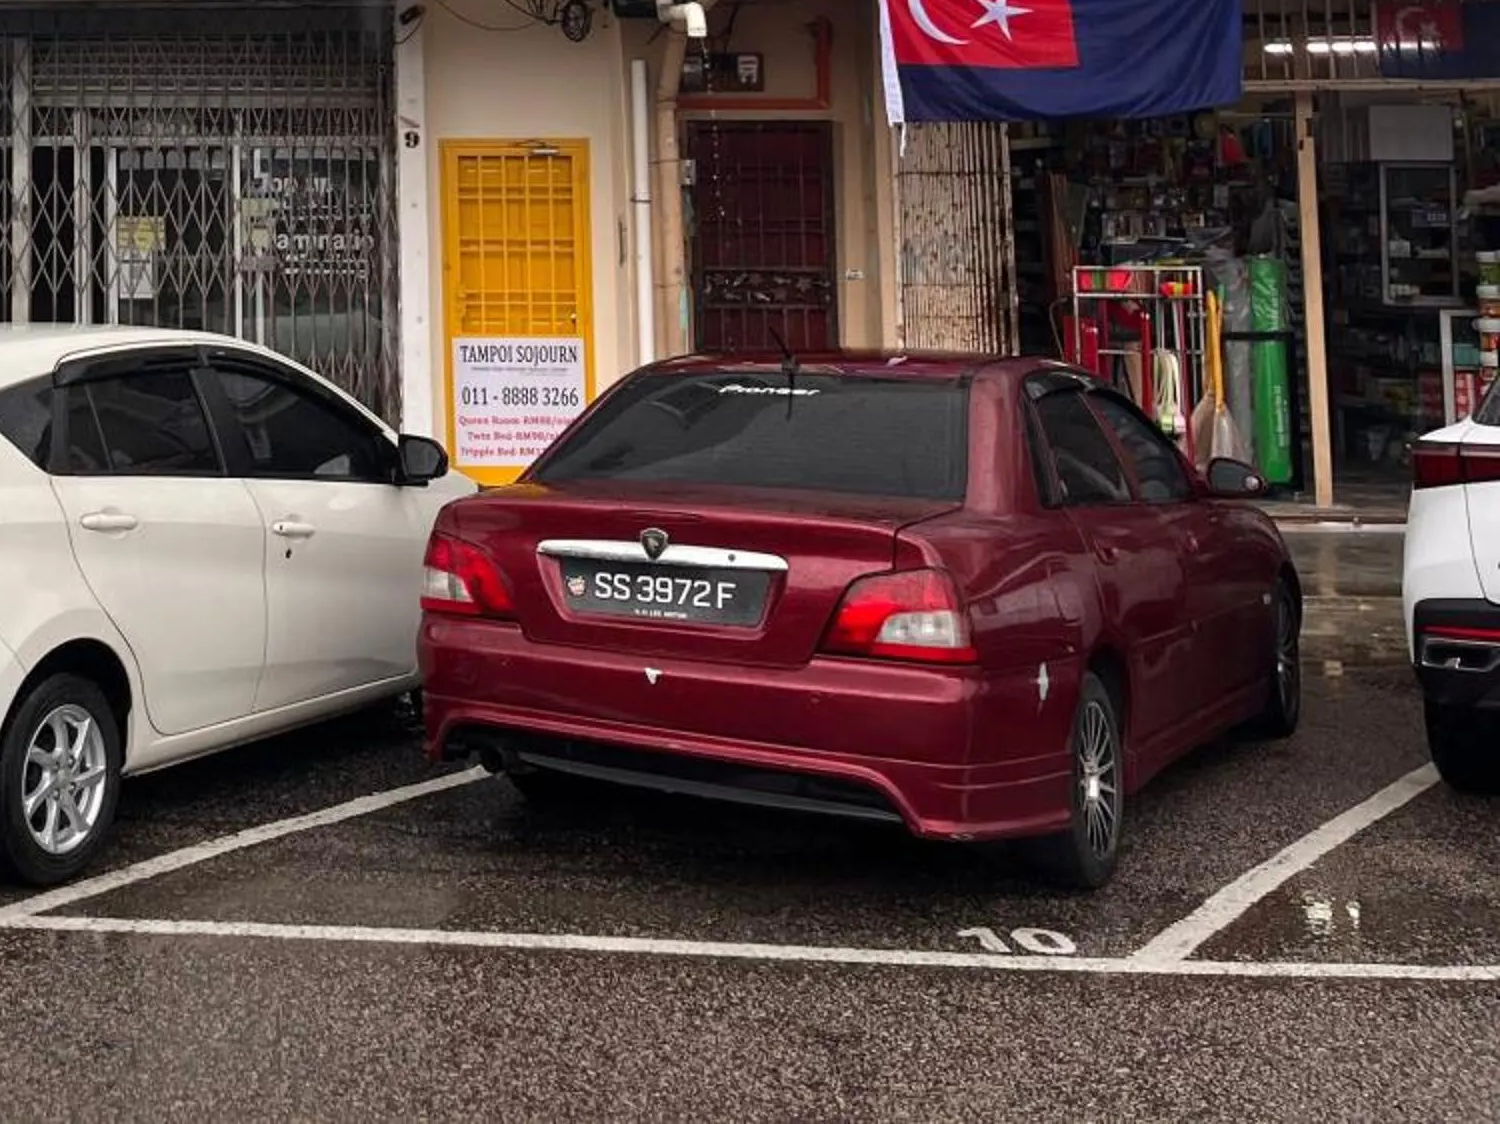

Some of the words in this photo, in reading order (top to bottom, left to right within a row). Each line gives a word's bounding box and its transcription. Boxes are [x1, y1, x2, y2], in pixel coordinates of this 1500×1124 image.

[403, 131, 420, 149] 9
[459, 345, 513, 363] TAMPOI
[516, 345, 578, 366] SOJOURN
[461, 387, 488, 405] 011
[502, 386, 539, 406] 8888
[542, 387, 579, 407] 3266
[956, 927, 1077, 954] 10
